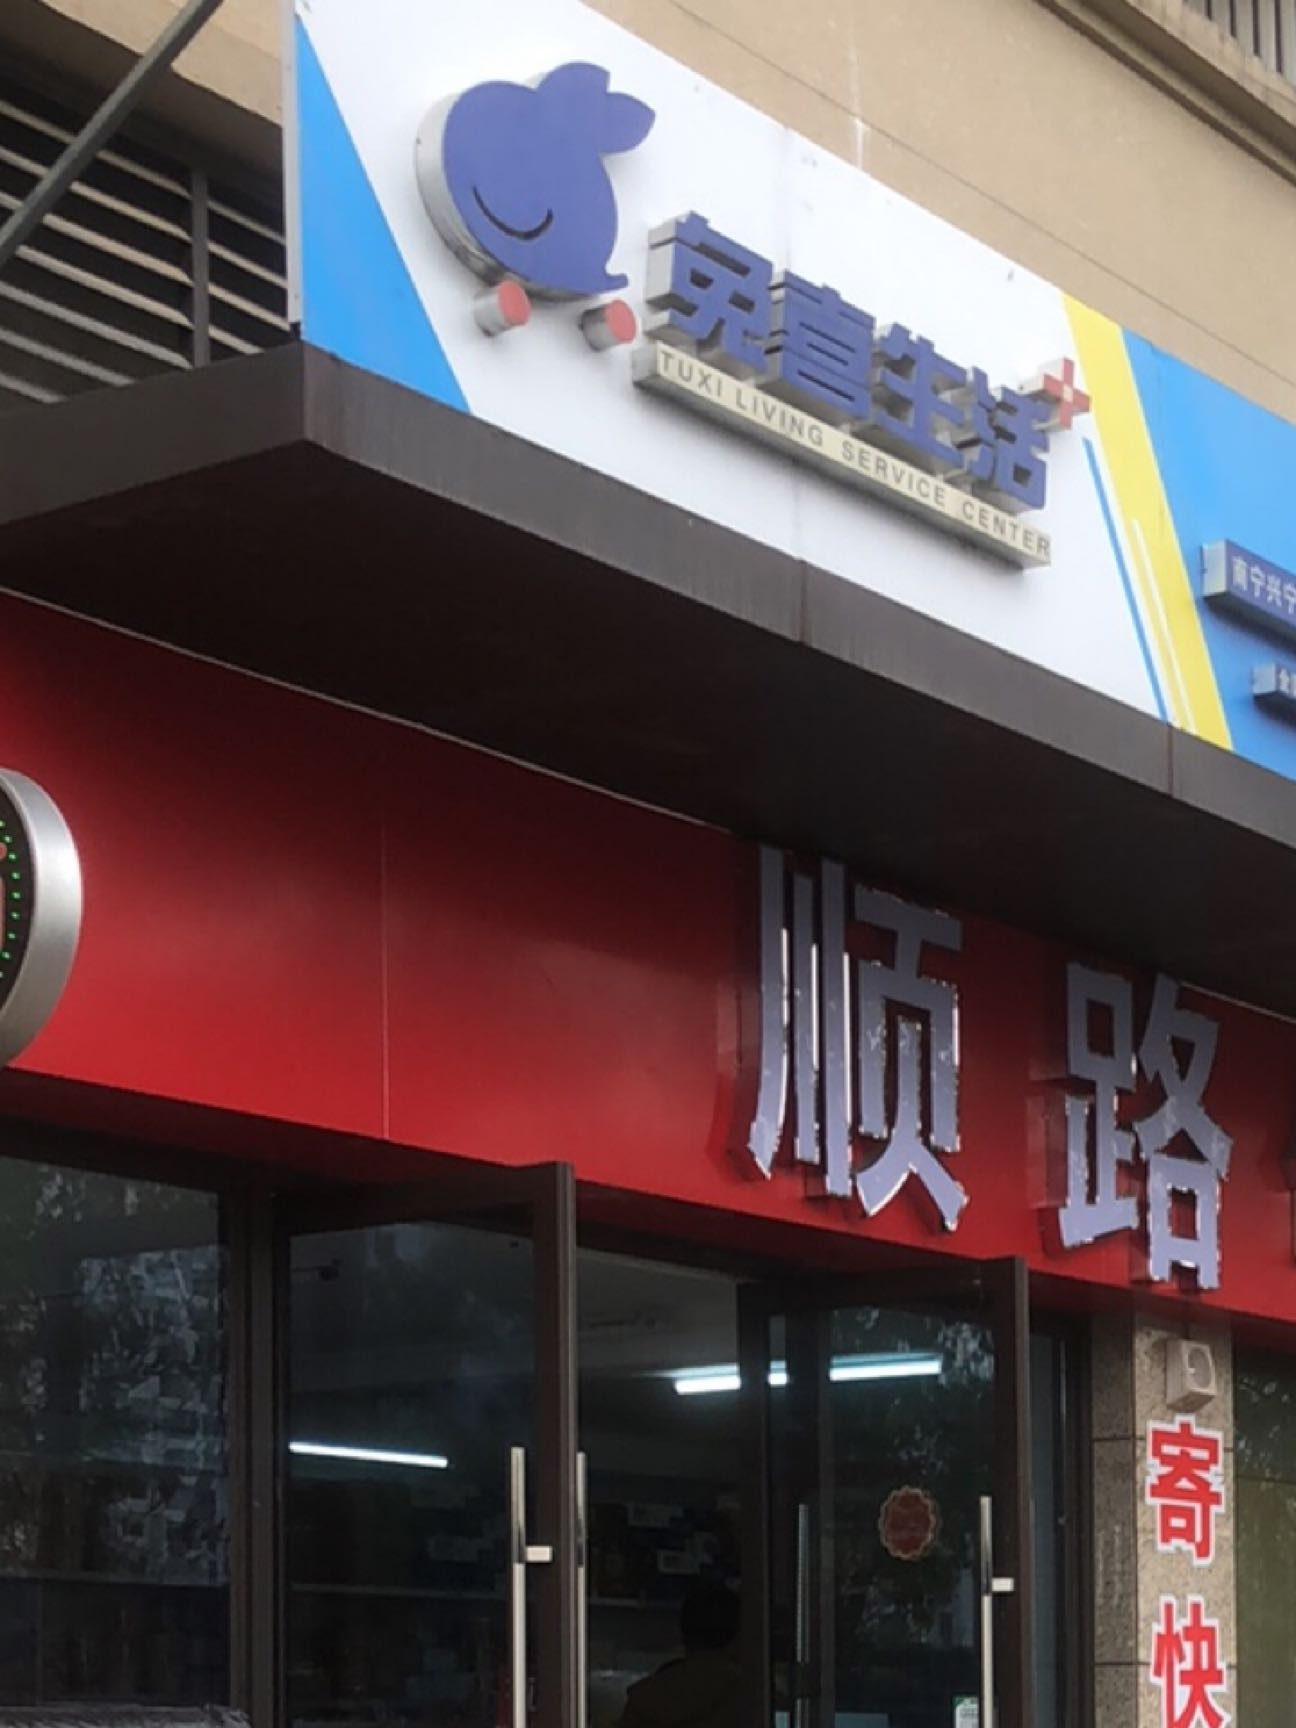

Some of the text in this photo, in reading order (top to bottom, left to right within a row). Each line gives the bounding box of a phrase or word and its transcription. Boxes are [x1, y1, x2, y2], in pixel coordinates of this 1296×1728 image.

[658, 348, 1050, 557] TUXI LIVING SERVICE CENTER
